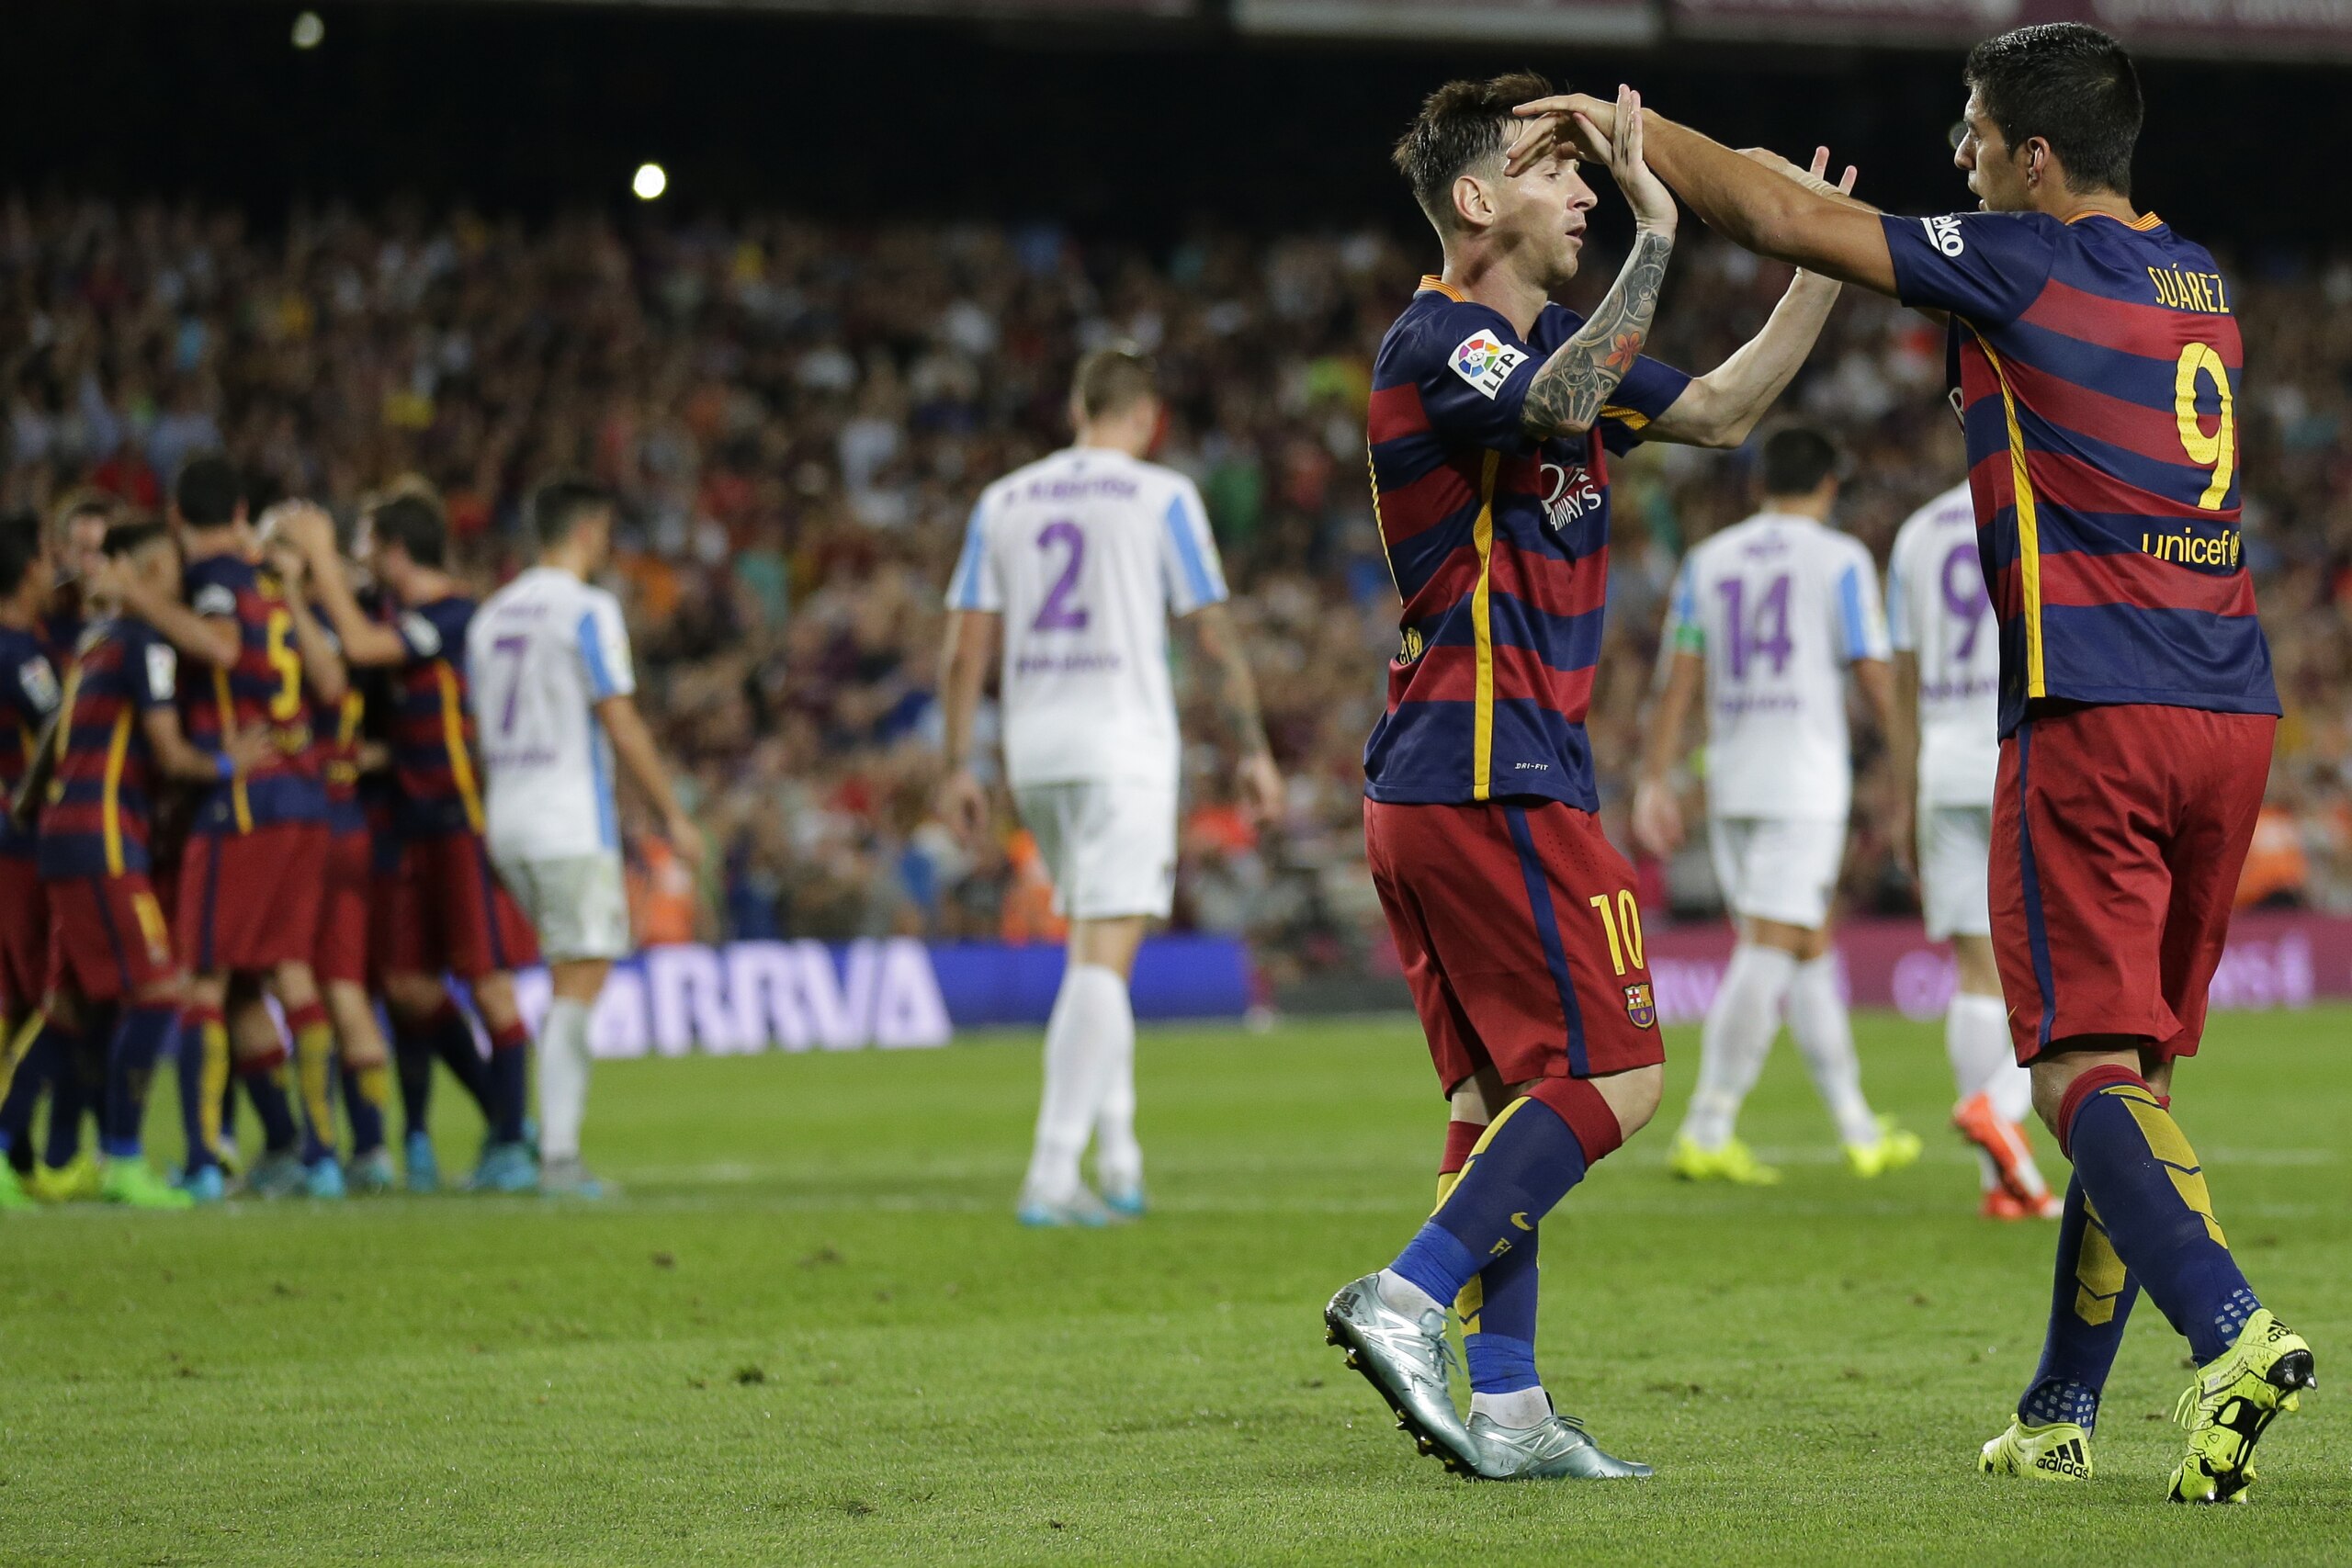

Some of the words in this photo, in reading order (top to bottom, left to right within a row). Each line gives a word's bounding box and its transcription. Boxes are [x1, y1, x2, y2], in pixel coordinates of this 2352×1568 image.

[1931, 212, 1964, 257] eko
[2147, 263, 2230, 313] SUÁREZ
[1482, 354, 1516, 392] LFP
[2174, 342, 2234, 511] 9
[1032, 521, 1089, 632] 2
[2142, 526, 2230, 566] unicef
[1716, 573, 1794, 680] 14
[1941, 544, 1991, 660] 9
[266, 606, 301, 721] 5
[493, 635, 529, 736] 7
[1514, 762, 1549, 771] DRI-FIT
[1589, 889, 1644, 976] 10
[2036, 1457, 2090, 1481] adidas
